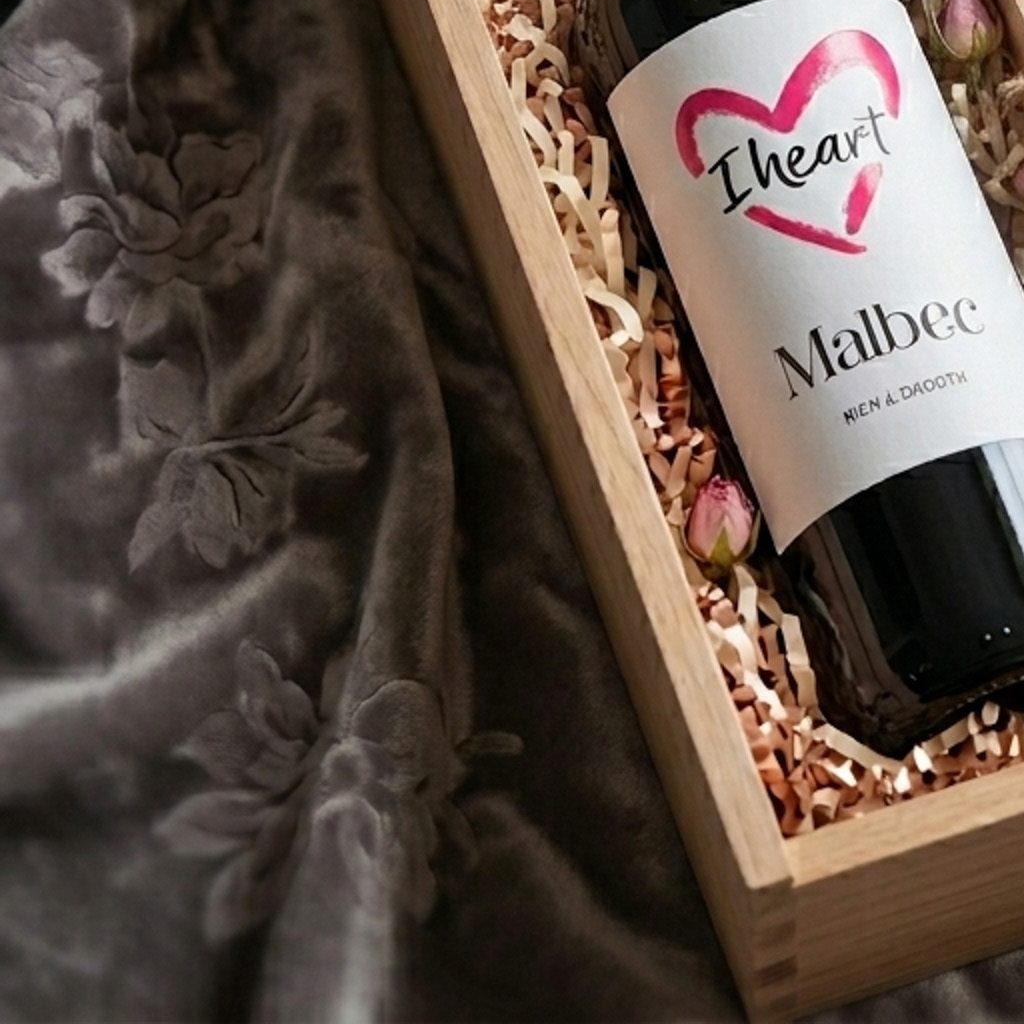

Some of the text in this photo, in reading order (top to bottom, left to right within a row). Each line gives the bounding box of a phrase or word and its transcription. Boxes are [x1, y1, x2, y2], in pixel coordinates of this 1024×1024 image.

[707, 105, 891, 215] I heart
[773, 296, 986, 402] Malbec
